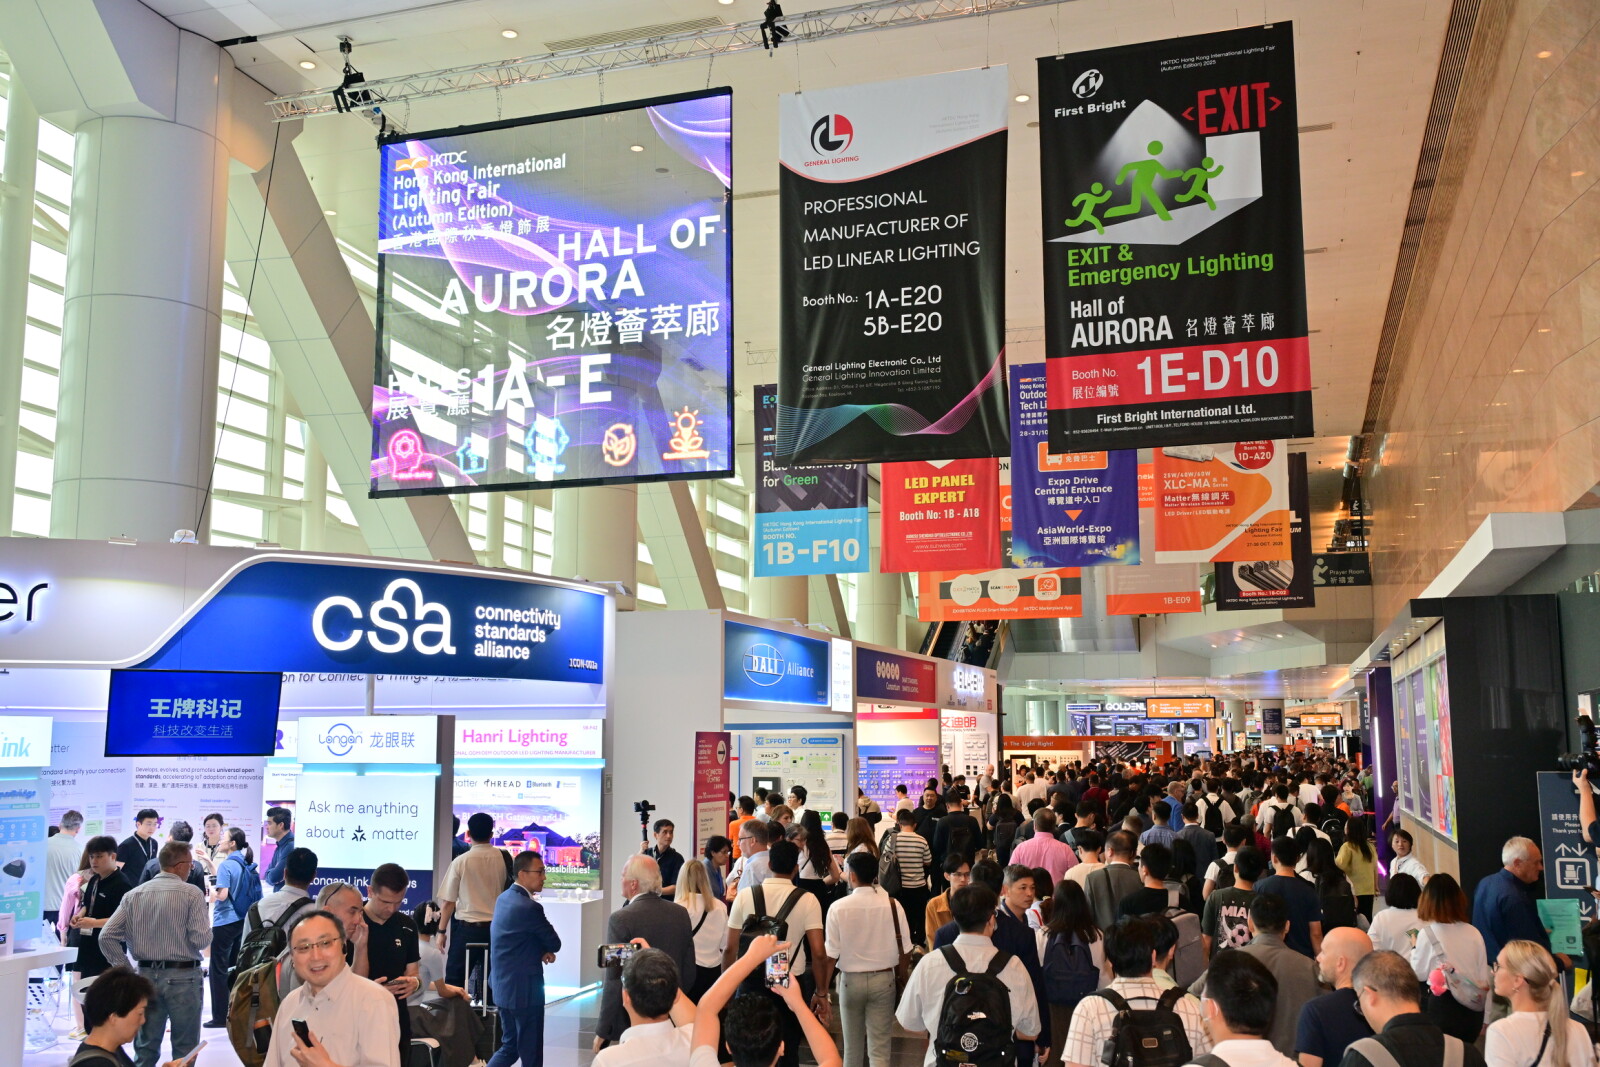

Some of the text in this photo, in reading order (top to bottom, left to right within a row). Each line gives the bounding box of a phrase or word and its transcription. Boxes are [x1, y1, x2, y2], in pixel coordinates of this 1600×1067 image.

[1160, 58, 1180, 66] HKTDC
[1180, 56, 1195, 64] Hong
[1196, 54, 1210, 62] Kong
[1210, 50, 1242, 59] International
[1243, 47, 1264, 56] Lighting
[1054, 99, 1127, 118] First Bright
[1197, 82, 1270, 135] EXIT
[430, 150, 468, 167] HKTDC
[804, 155, 860, 168] GENERAL LIGHTING
[393, 153, 567, 192] Hong Kong International
[393, 181, 501, 211] Lighting Fair
[804, 190, 928, 216] PROFESSIONAL
[392, 201, 514, 231] (Autumn Edition)
[803, 213, 969, 244] MANUFACTURER OF
[558, 215, 721, 262] HALL OF
[804, 241, 981, 271] LED LINEAR LIGHTING
[1067, 243, 1134, 267] EXIT &
[1068, 252, 1274, 287] Emergency Lighting
[440, 259, 646, 317] AURORA
[803, 285, 942, 310] Booth No.: 1A-E20
[1070, 296, 1125, 319] Hall of
[545, 300, 720, 350] 名燈薈萃廊
[864, 312, 942, 336] 5B-E20
[1070, 315, 1174, 349] AURORA
[1185, 312, 1275, 338] 名燈薈萃廊
[802, 354, 942, 373] General Lighting Electronic Co., Ltd
[1136, 346, 1279, 396] 1E-D10
[802, 365, 942, 383] General Lighting Innovation Limited
[1072, 368, 1119, 380] Booth No.
[1072, 384, 1120, 400] 展位編號
[1020, 402, 1038, 411] Tech
[1096, 403, 1257, 425] First Bright International Ltd.
[1238, 451, 1271, 461] 1D-A20
[763, 474, 818, 488] for Green
[904, 474, 975, 490] LED PANEL
[1034, 484, 1113, 496] Central Entrance
[1048, 476, 1099, 487] Expo Drive
[1164, 478, 1211, 490] XLC-MA
[914, 490, 966, 505] EXPERT
[899, 510, 924, 521] Booth
[926, 509, 942, 520] No:
[1037, 525, 1112, 535] AsiaWorld-Expo
[762, 538, 860, 565] 1B-F10
[1163, 596, 1191, 604] 1B-E09
[312, 578, 456, 655] csa
[475, 604, 561, 630] connectivity
[474, 624, 546, 644] standards
[474, 642, 531, 660] alliance
[752, 656, 814, 678] DALI Alliance
[148, 698, 242, 719] 王牌科记
[152, 725, 234, 737] 科技改变生活
[318, 731, 415, 749] Longan 龙眼联
[463, 729, 568, 747] Hanri Lighting
[483, 778, 522, 788] THREAD
[308, 800, 418, 817] Ask me anything
[306, 826, 419, 840] about matter
